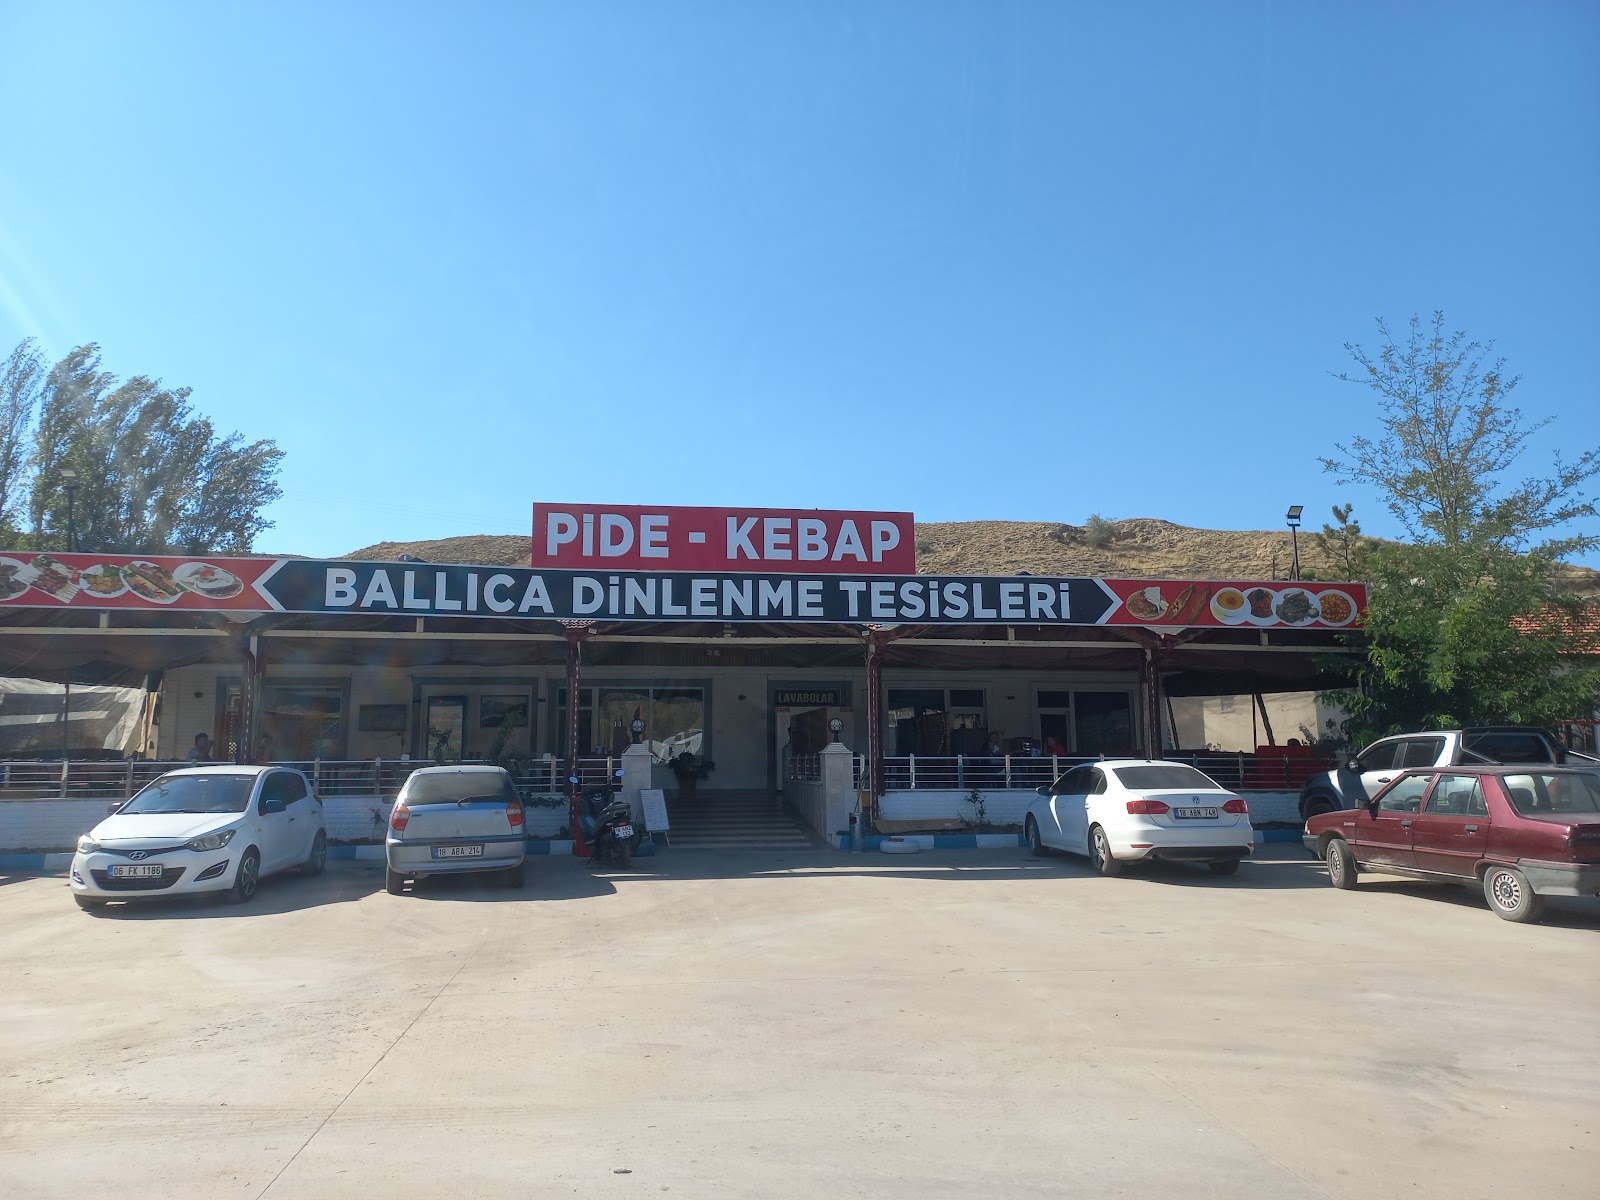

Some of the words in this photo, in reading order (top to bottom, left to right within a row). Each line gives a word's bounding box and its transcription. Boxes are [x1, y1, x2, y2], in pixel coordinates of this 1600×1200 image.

[688, 531, 706, 543] -
[726, 516, 900, 563] KEBAP
[325, 567, 555, 614] BALLICA
[778, 692, 834, 703] LAVABOLAR
[438, 847, 446, 857] 18
[451, 847, 465, 856] ABA
[468, 846, 480, 856] 214
[113, 865, 124, 876] 06
[128, 865, 138, 875] FK
[142, 864, 161, 875] 1186
